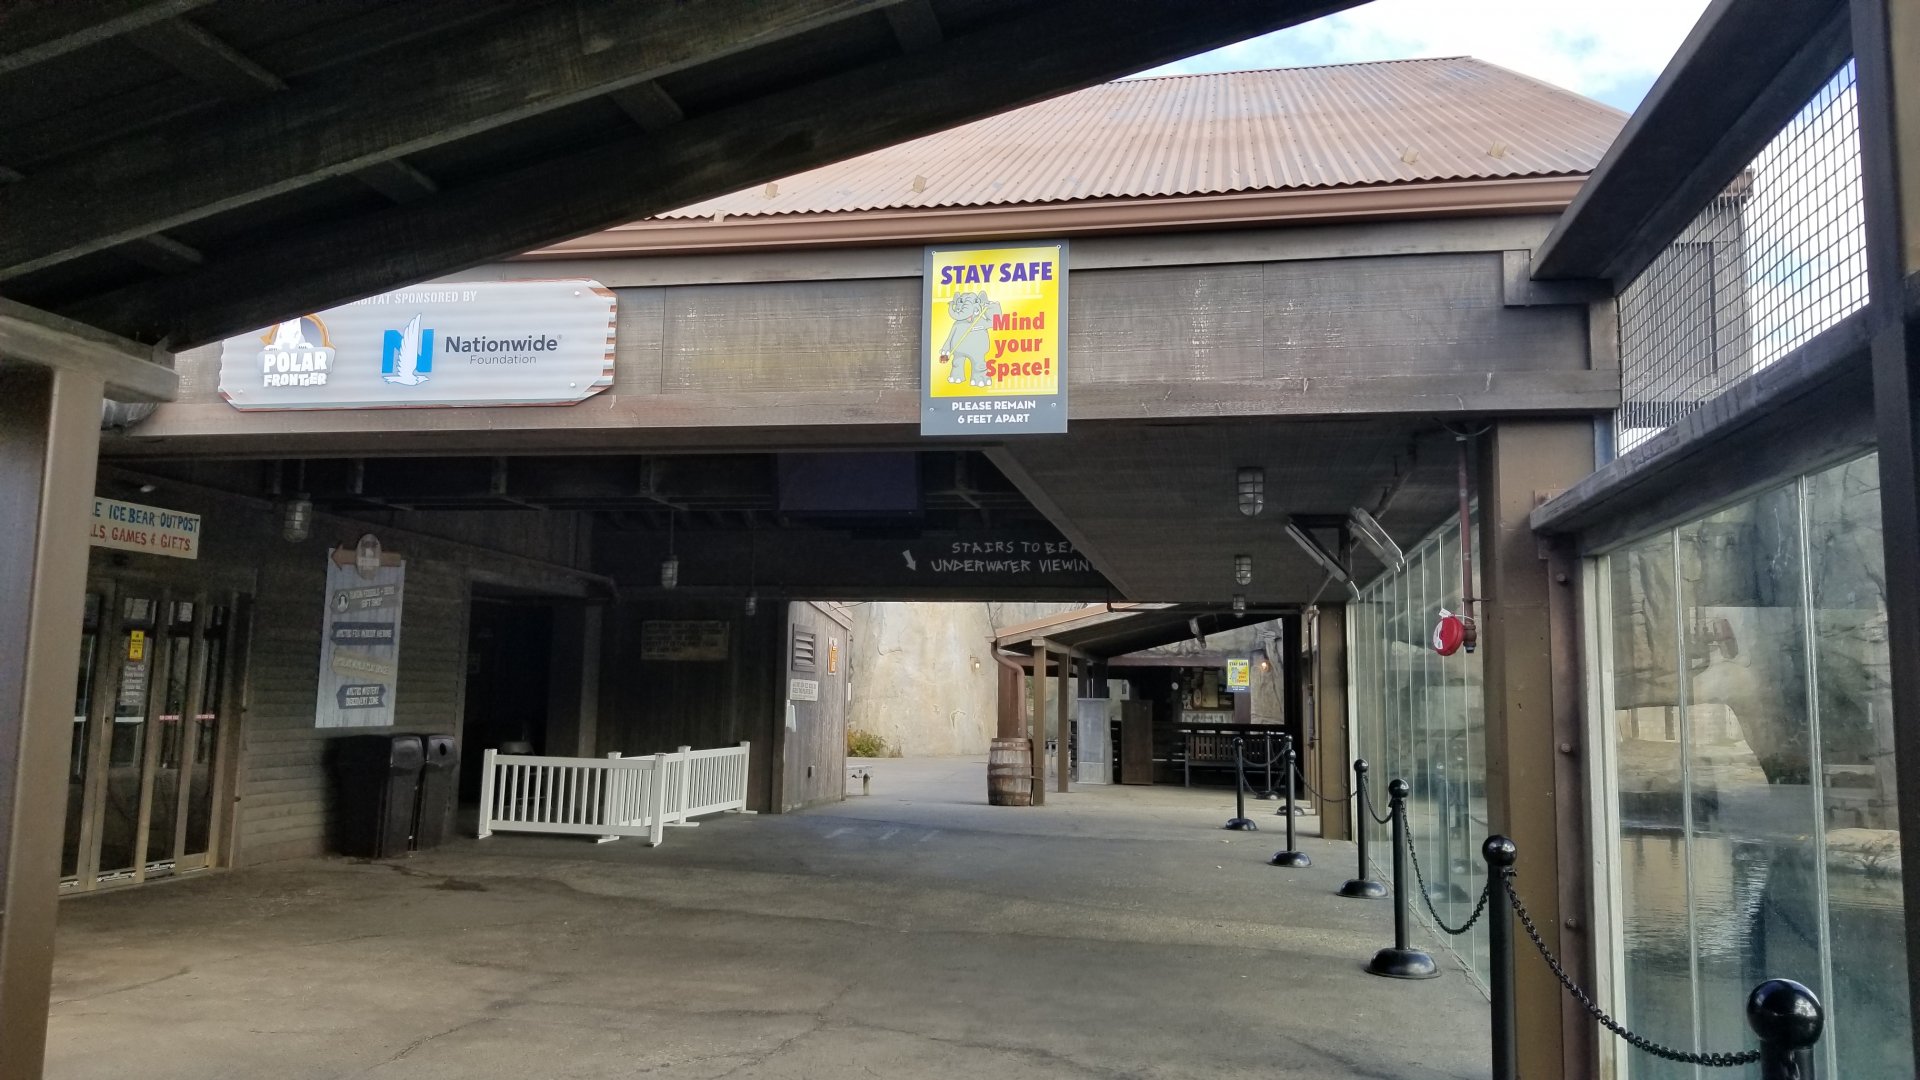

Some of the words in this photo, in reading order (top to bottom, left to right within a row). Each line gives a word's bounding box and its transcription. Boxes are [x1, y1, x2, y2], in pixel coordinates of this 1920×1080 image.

[941, 263, 994, 285] STAY
[999, 261, 1053, 283] SAFE
[394, 291, 459, 304] SPONSORED
[463, 290, 477, 302] BY
[992, 312, 1045, 332] Mind
[445, 334, 558, 353] Nationwide
[994, 338, 1043, 358] your
[264, 349, 328, 373] POLAR
[469, 354, 537, 365] Foundation
[985, 358, 1050, 382] Space!
[263, 373, 328, 388] FRONTIER
[952, 401, 993, 411] PLEASE
[994, 400, 1036, 410] REMAIN
[957, 414, 965, 424] 6
[967, 414, 993, 424] FEET
[994, 413, 1030, 423] APART
[109, 504, 126, 521] ICE
[128, 508, 155, 527] BEAR
[160, 512, 200, 533] OUTPOST
[111, 527, 147, 545] GAMES
[952, 541, 1014, 554] STAIRS
[1020, 541, 1040, 553] TO
[930, 559, 1031, 574] UNDERWATER
